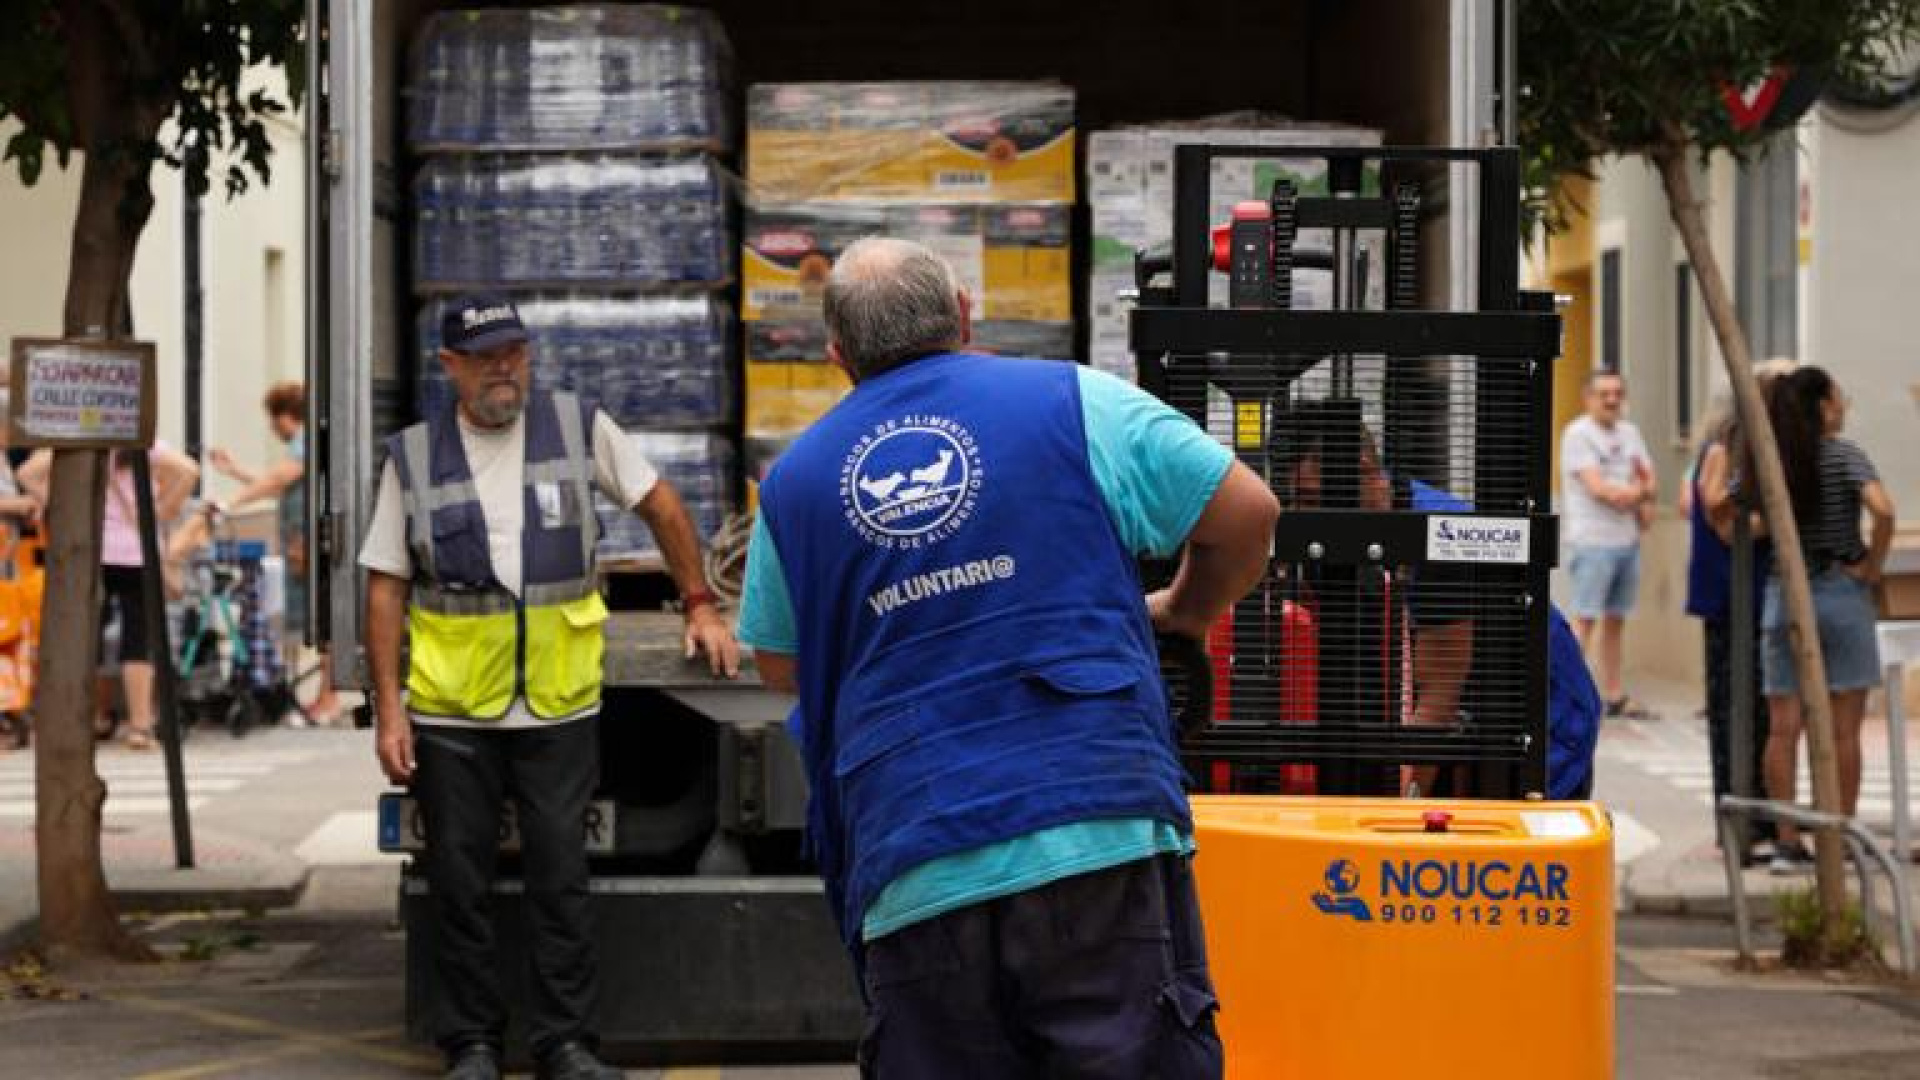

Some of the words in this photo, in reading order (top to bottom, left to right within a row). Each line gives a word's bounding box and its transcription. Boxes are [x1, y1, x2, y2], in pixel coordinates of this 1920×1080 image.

[1457, 528, 1521, 543] NOUCAR
[867, 554, 1016, 617] VOLUNTARI@
[1380, 859, 1569, 901] NOUCAR
[1381, 905, 1436, 923] 900
[1452, 905, 1501, 926] 112
[1519, 906, 1570, 926] 192
